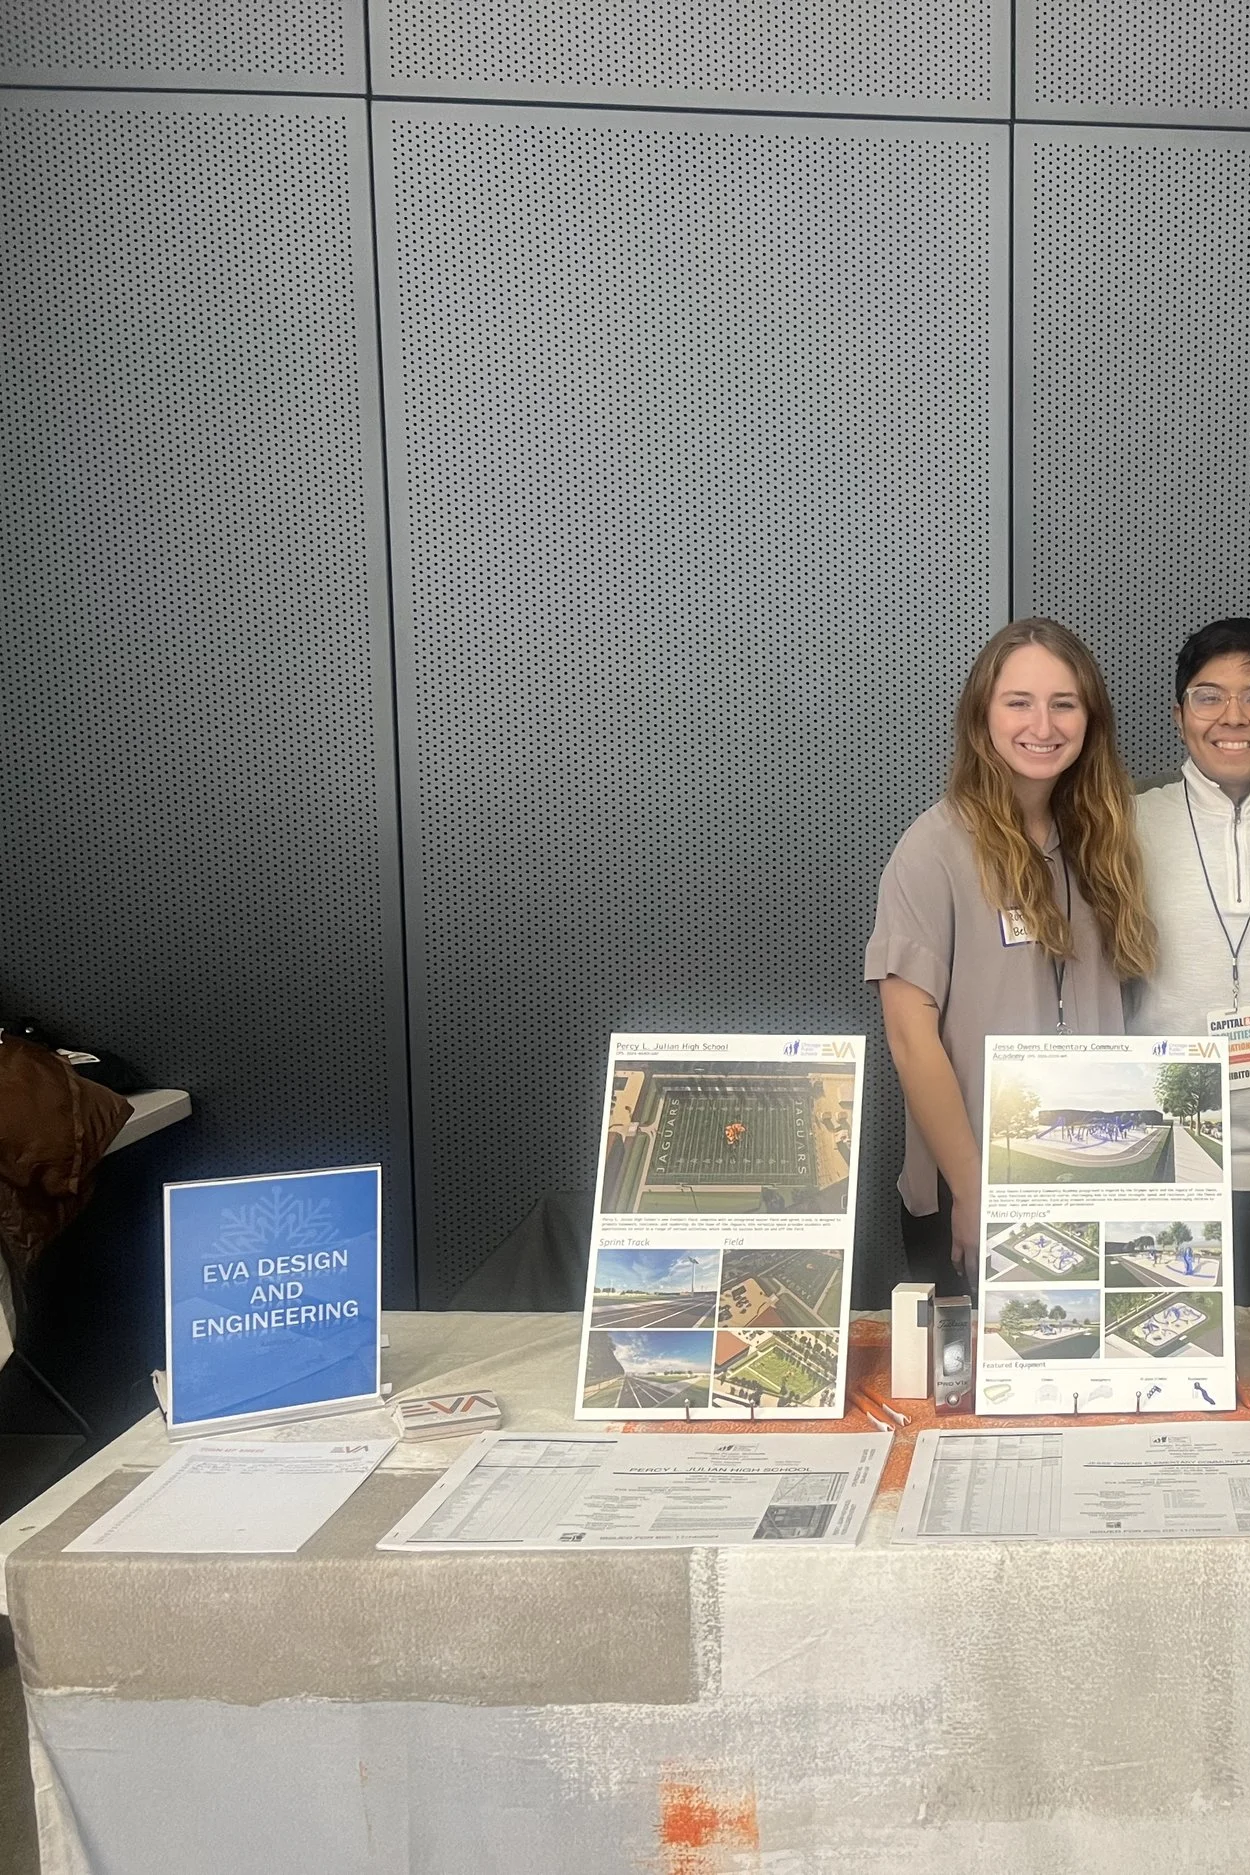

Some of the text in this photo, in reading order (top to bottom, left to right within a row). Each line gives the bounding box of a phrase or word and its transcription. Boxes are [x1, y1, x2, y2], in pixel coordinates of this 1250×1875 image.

[616, 1042, 640, 1052] Percy
[654, 1042, 680, 1051] Julian
[682, 1042, 699, 1053] High
[702, 1043, 729, 1051] School
[821, 1041, 856, 1058] EVA
[1044, 1043, 1088, 1052] Elementary
[1090, 1043, 1129, 1052] Community
[1188, 1042, 1221, 1059] EVA
[992, 1052, 1025, 1061] Academy
[656, 1099, 679, 1173] JAGUARS
[795, 1100, 807, 1174] JAGUARS
[599, 1238, 650, 1247] Sprint Track
[724, 1238, 744, 1246] Field
[203, 1250, 348, 1284] EVA DESIGN
[250, 1281, 304, 1304] AND
[192, 1300, 359, 1338] ENGINEERING
[1015, 1361, 1046, 1370] Equipment
[401, 1395, 498, 1418] EVA
